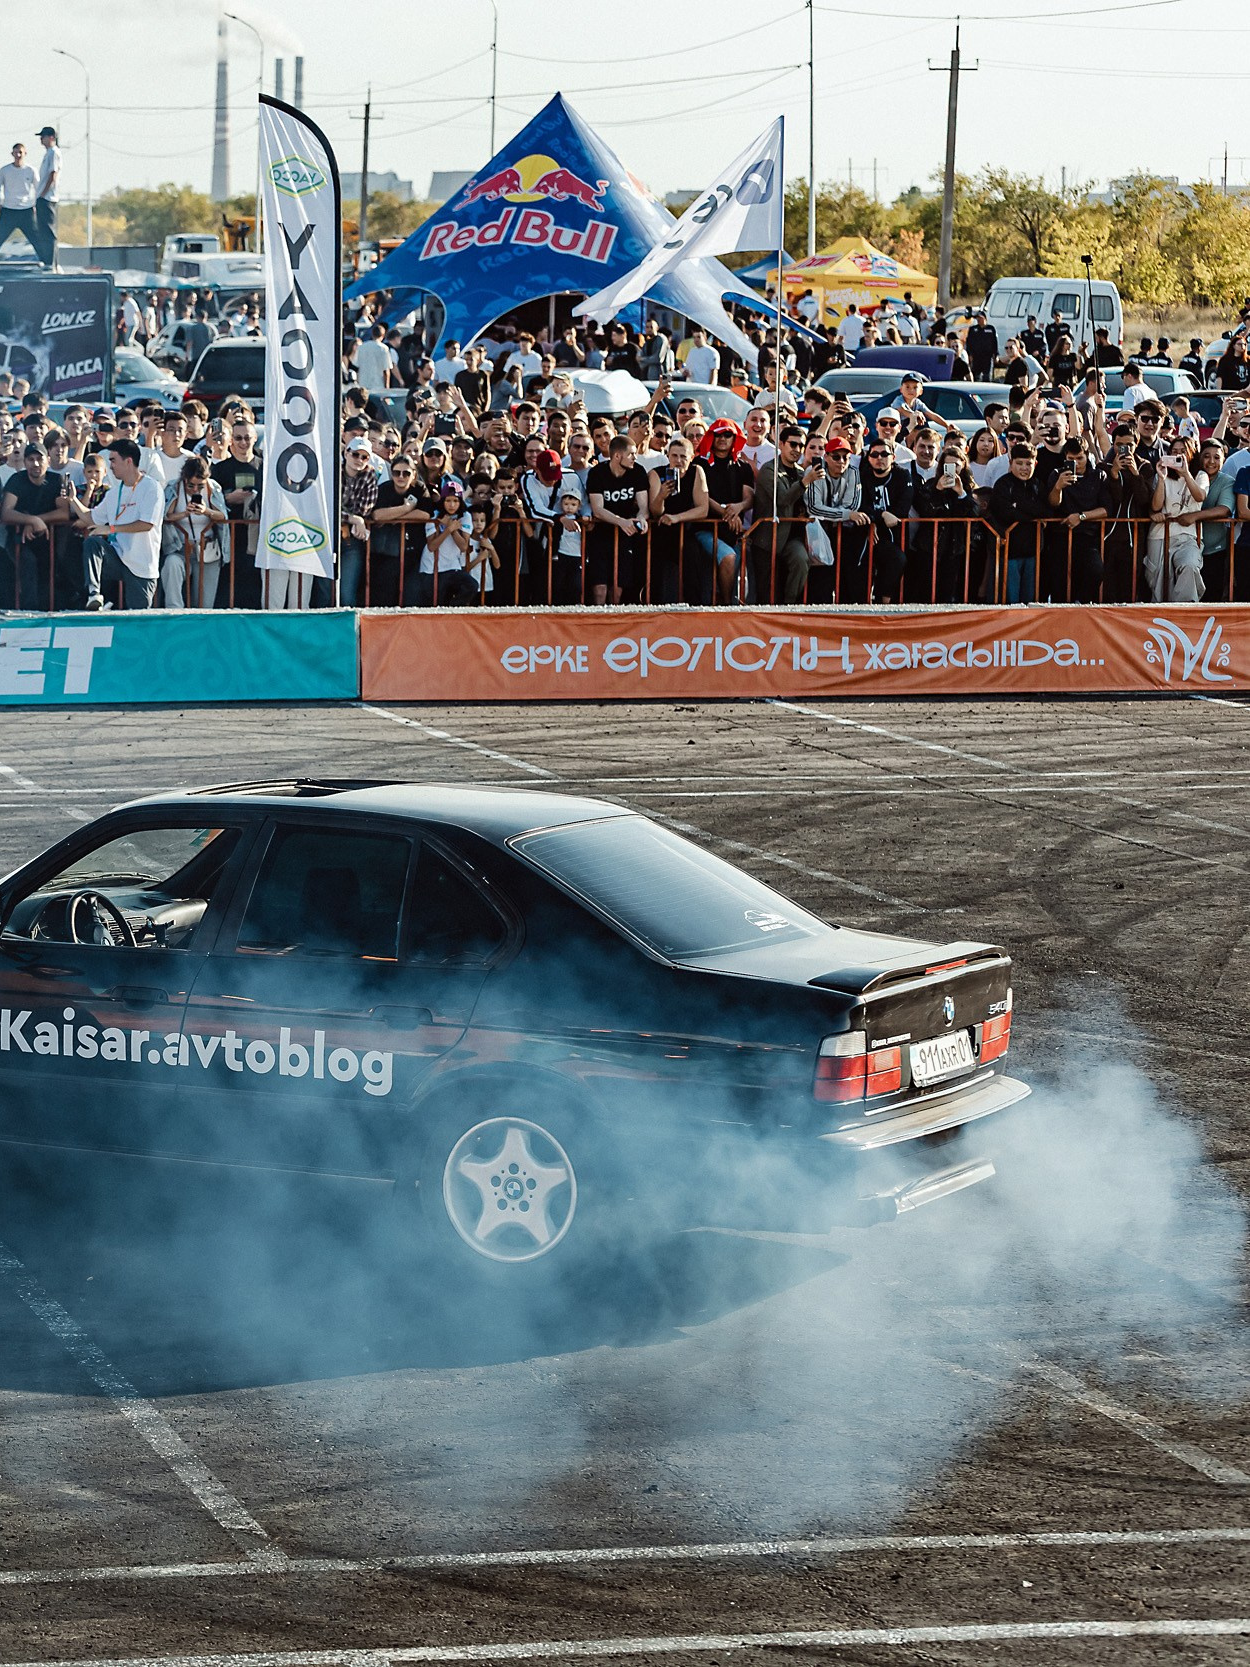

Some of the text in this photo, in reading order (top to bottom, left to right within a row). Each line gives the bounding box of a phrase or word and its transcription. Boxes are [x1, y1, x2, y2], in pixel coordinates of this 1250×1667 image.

[420, 208, 516, 260] Red
[510, 208, 618, 264] Bull
[41, 310, 96, 329] LOW KZ
[56, 357, 103, 382] КАССА
[603, 487, 634, 502] BOSS
[0, 1007, 394, 1097] Kaisar.avtoblog
